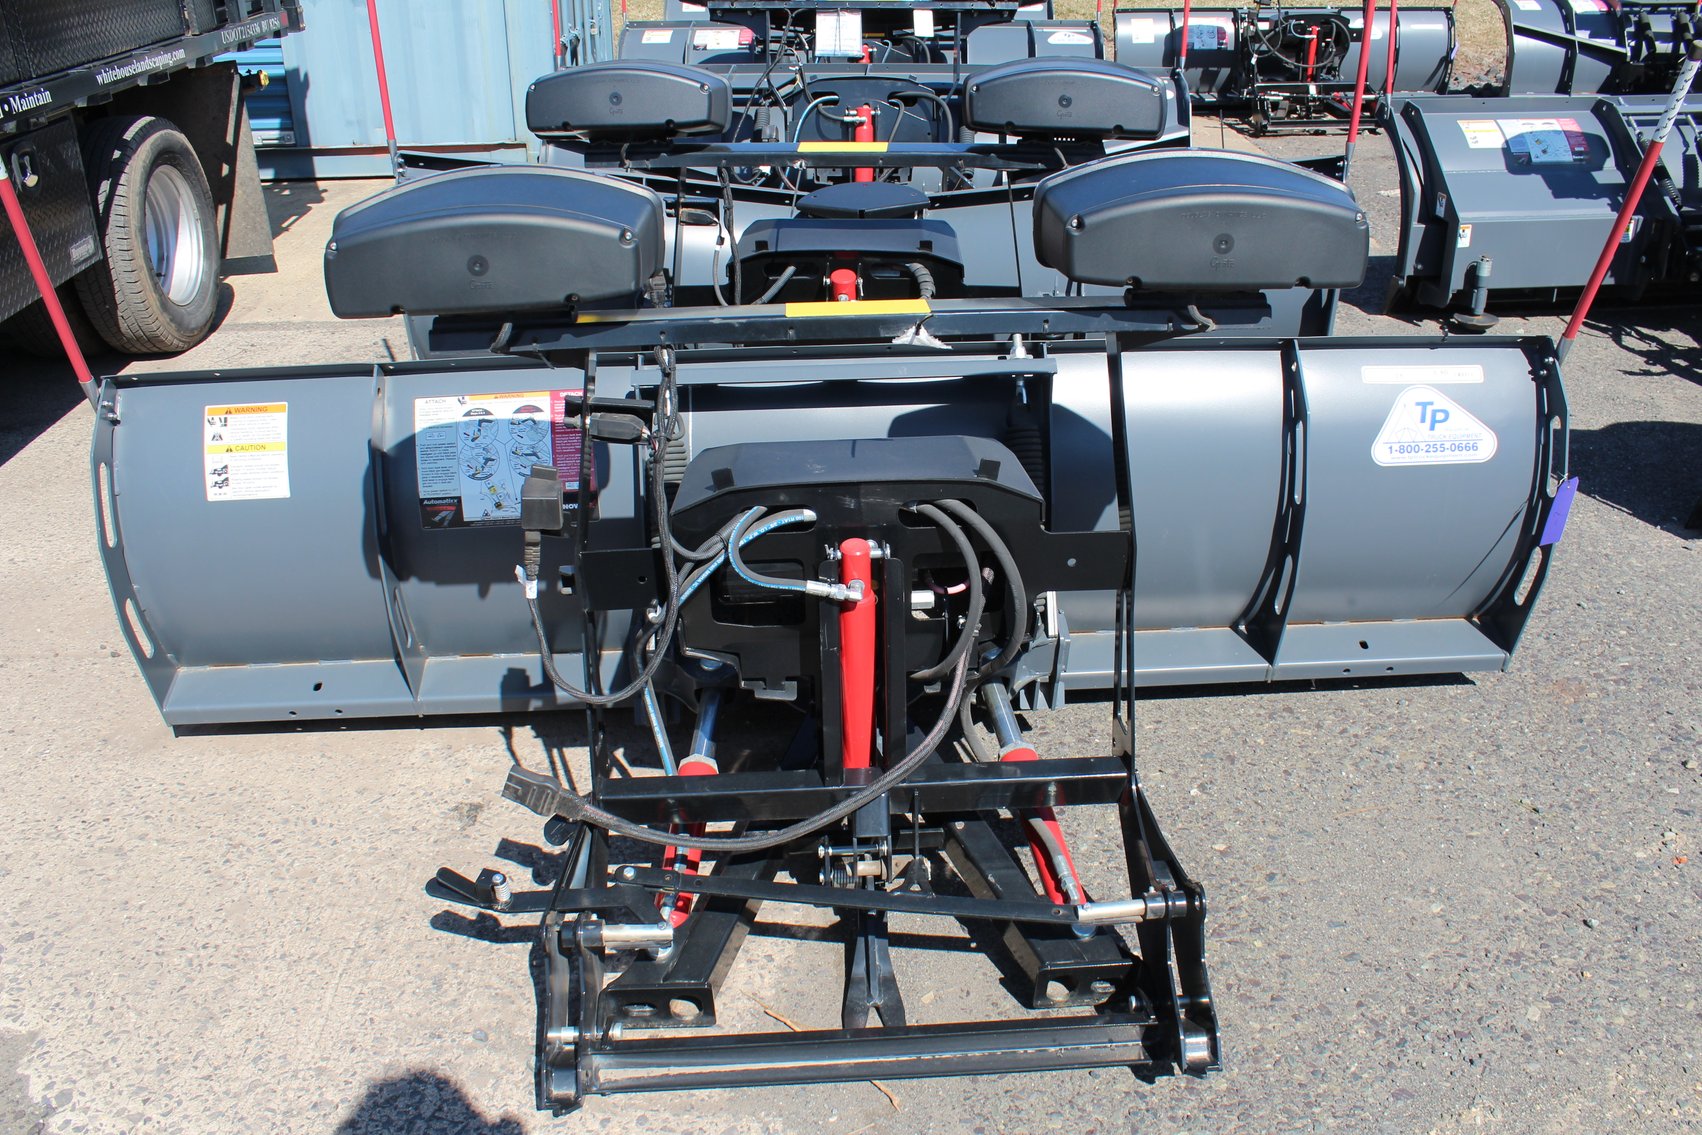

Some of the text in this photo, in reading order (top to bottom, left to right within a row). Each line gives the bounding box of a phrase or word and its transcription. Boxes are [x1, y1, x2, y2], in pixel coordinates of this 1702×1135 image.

[95, 47, 186, 86] whitehouselandscaping.com
[10, 88, 52, 114] Maintain
[1415, 401, 1450, 431] TP
[1388, 442, 1478, 454] 1-800-255-0666
